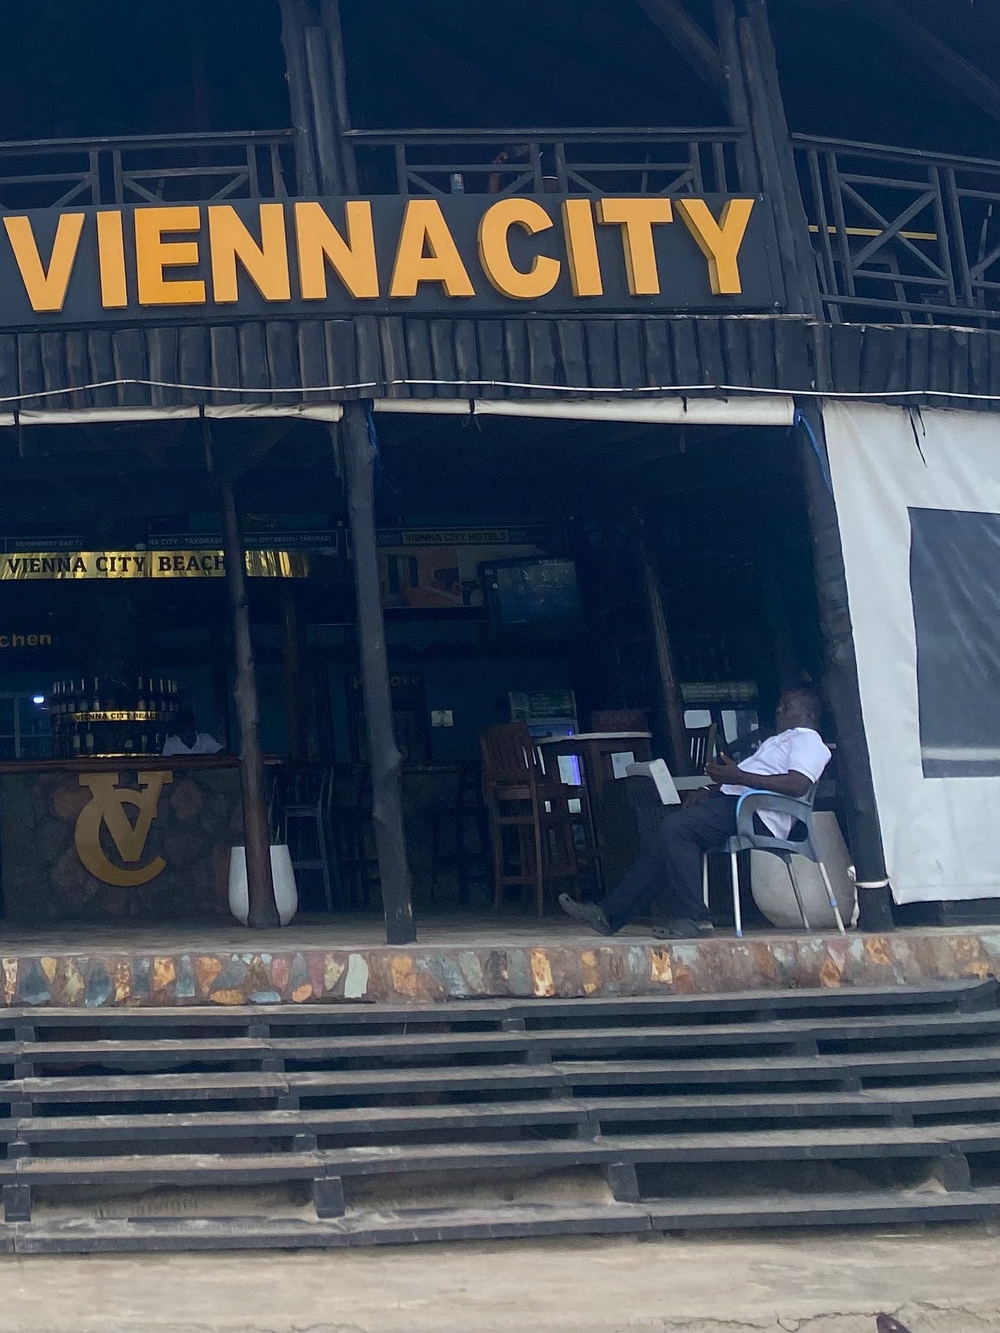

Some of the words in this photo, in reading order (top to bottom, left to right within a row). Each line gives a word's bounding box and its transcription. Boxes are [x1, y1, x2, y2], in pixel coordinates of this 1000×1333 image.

[405, 533, 441, 542] VIENNA
[8, 556, 87, 573] VIENNA
[95, 556, 146, 572] CITY
[158, 555, 225, 572] BEACH
